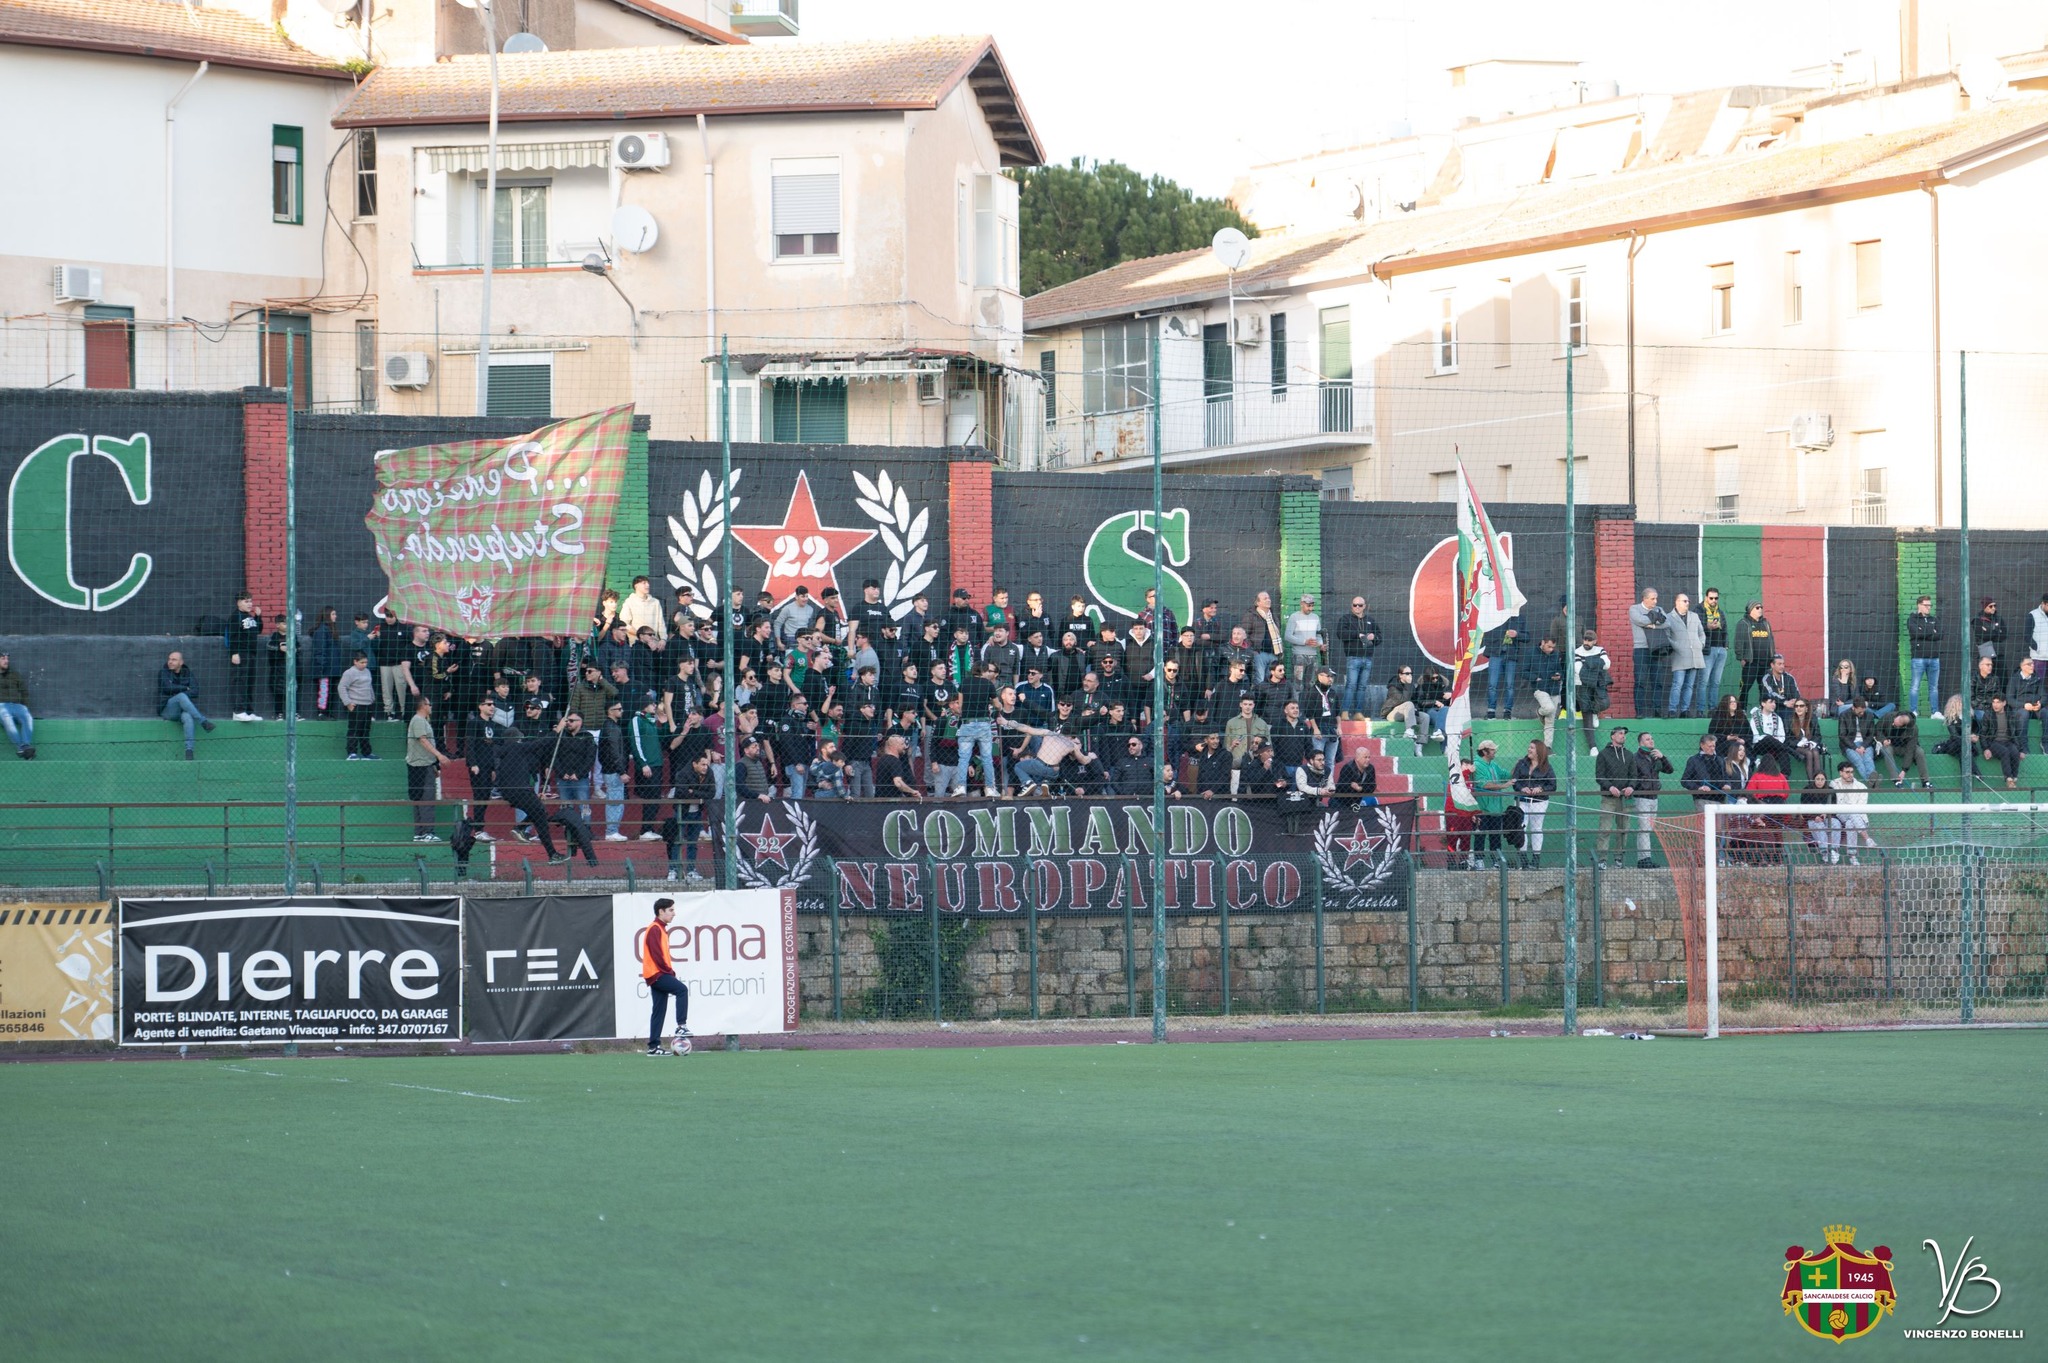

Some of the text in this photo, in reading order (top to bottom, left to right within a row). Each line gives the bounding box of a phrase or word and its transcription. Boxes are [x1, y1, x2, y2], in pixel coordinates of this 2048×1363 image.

[8, 432, 152, 611] C
[772, 534, 830, 578] 22
[1084, 508, 1194, 632] S
[756, 836, 781, 854] 22
[883, 805, 1253, 860] COMMANDO
[1350, 839, 1371, 856] 22
[835, 859, 1301, 913] NEUROPATICO
[784, 896, 794, 954] COSTRUZIONI
[145, 944, 440, 1003] Dierre
[636, 970, 766, 999] cruzioni
[786, 962, 796, 1025] PROGETAZIONI
[0, 1023, 45, 1033] 565846
[133, 1027, 176, 1040] Agente
[177, 1026, 190, 1038] di
[195, 1026, 237, 1038] vendita:
[239, 1025, 287, 1037] Gaetano
[289, 1024, 339, 1037] Vivacqua
[349, 1023, 375, 1035] info:
[377, 1023, 449, 1035] 347.0707167
[134, 1008, 449, 1023] PORTE: BLINDATE, INTERNE, TAGLIAFUOCO, DA GARAGE
